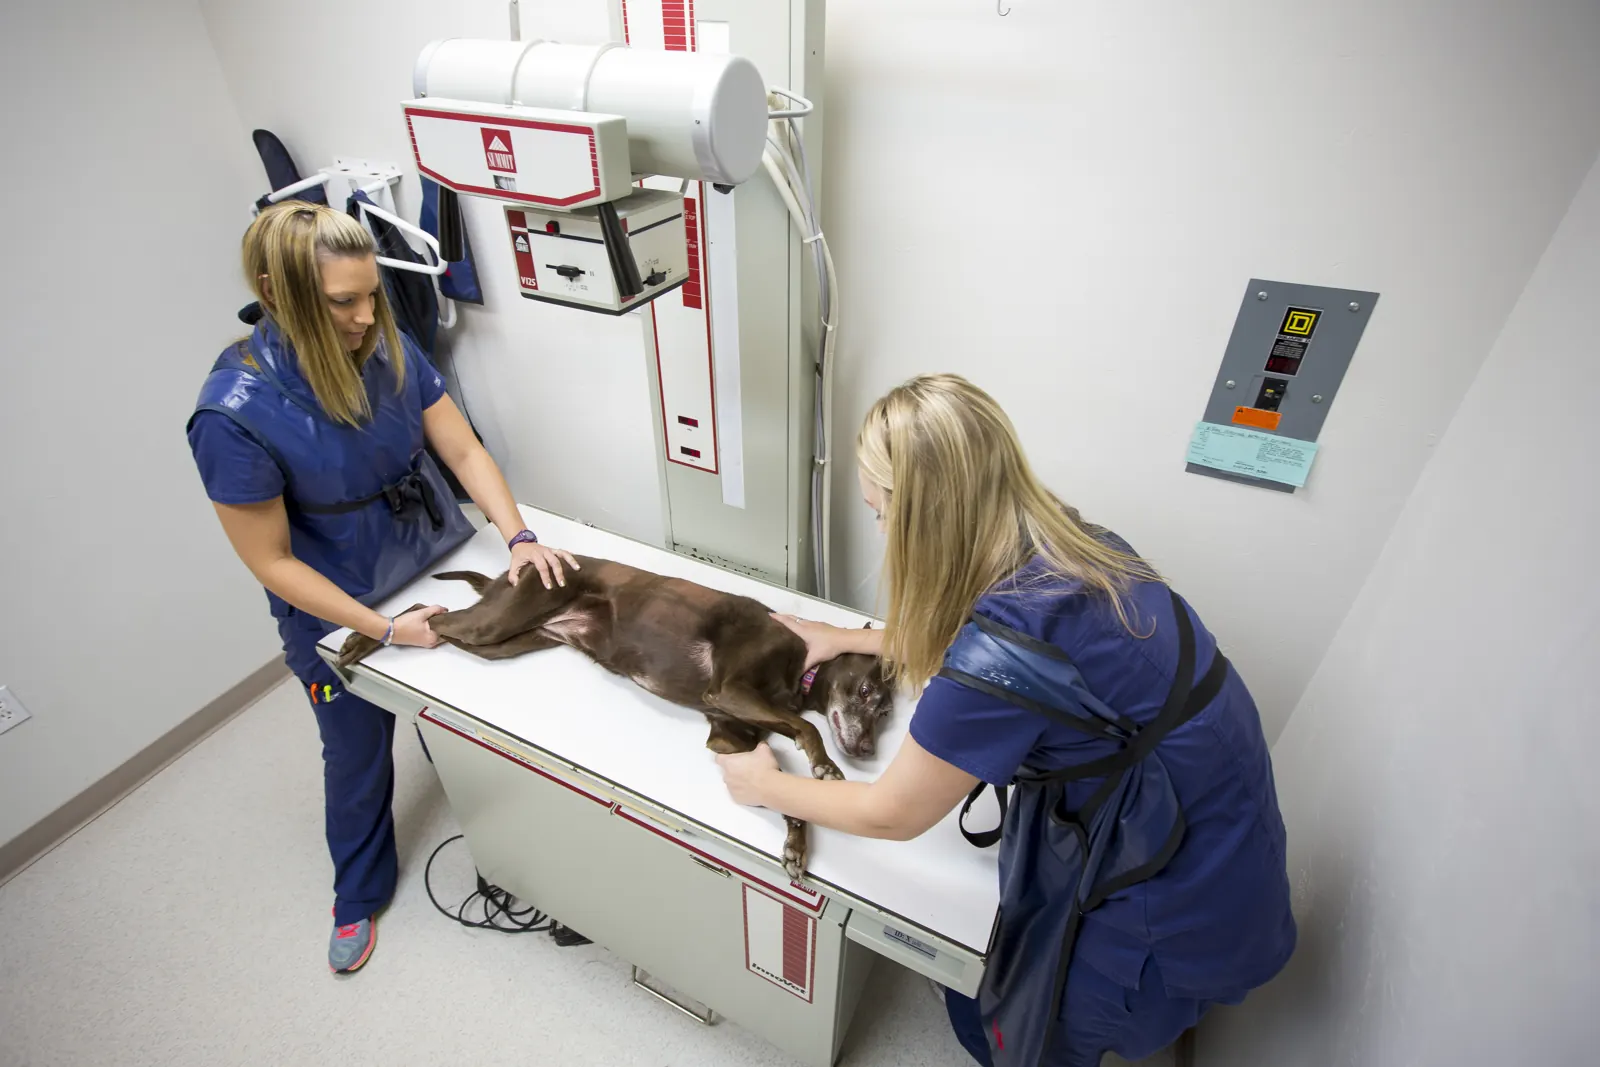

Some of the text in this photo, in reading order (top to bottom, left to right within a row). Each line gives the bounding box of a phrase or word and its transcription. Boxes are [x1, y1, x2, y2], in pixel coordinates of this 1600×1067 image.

[487, 151, 514, 170] SUMMIT
[521, 276, 536, 287] V125
[1289, 315, 1310, 331] D
[752, 963, 807, 995] InnoVet
